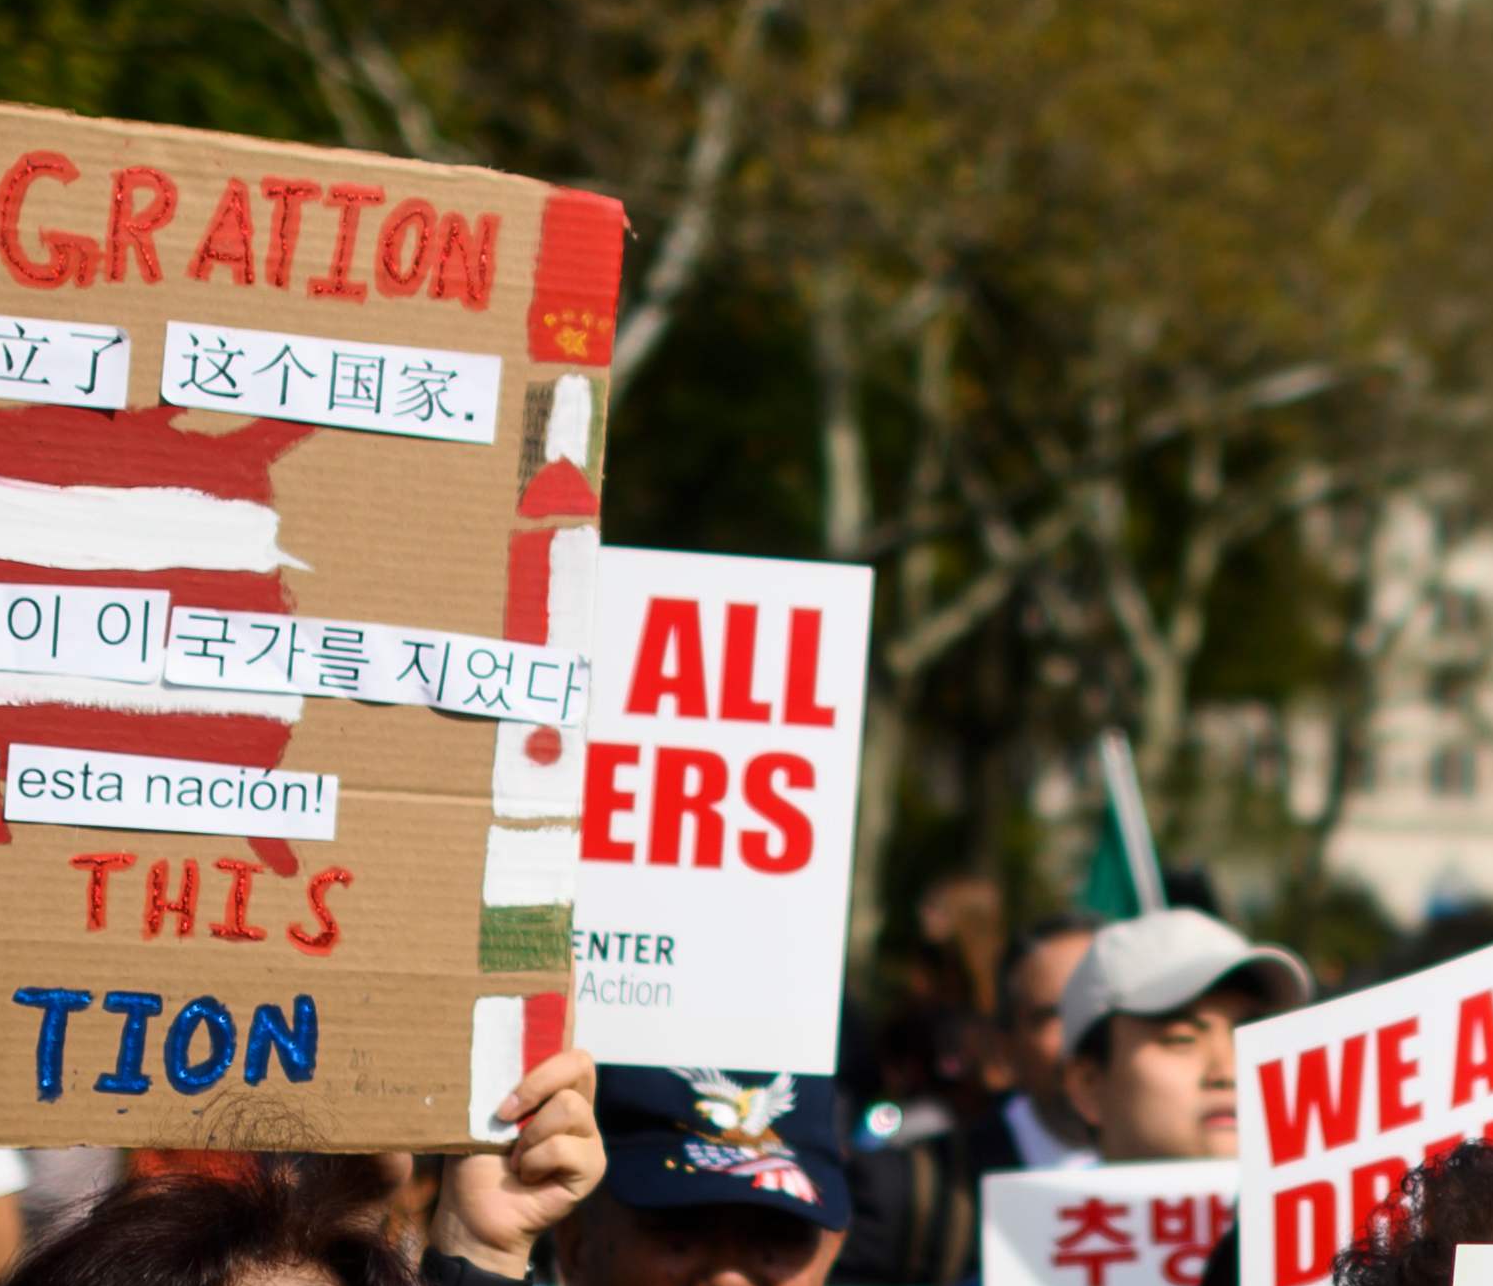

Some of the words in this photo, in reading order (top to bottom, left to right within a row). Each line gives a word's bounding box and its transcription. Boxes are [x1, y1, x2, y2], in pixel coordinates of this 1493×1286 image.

[397, 640, 581, 721] 지었다
[623, 596, 837, 730] ALL
[17, 765, 124, 804] esta
[145, 769, 324, 815] nación!
[70, 851, 354, 955] THIS
[578, 970, 672, 1008] Action
[1257, 1017, 1424, 1167] WE
